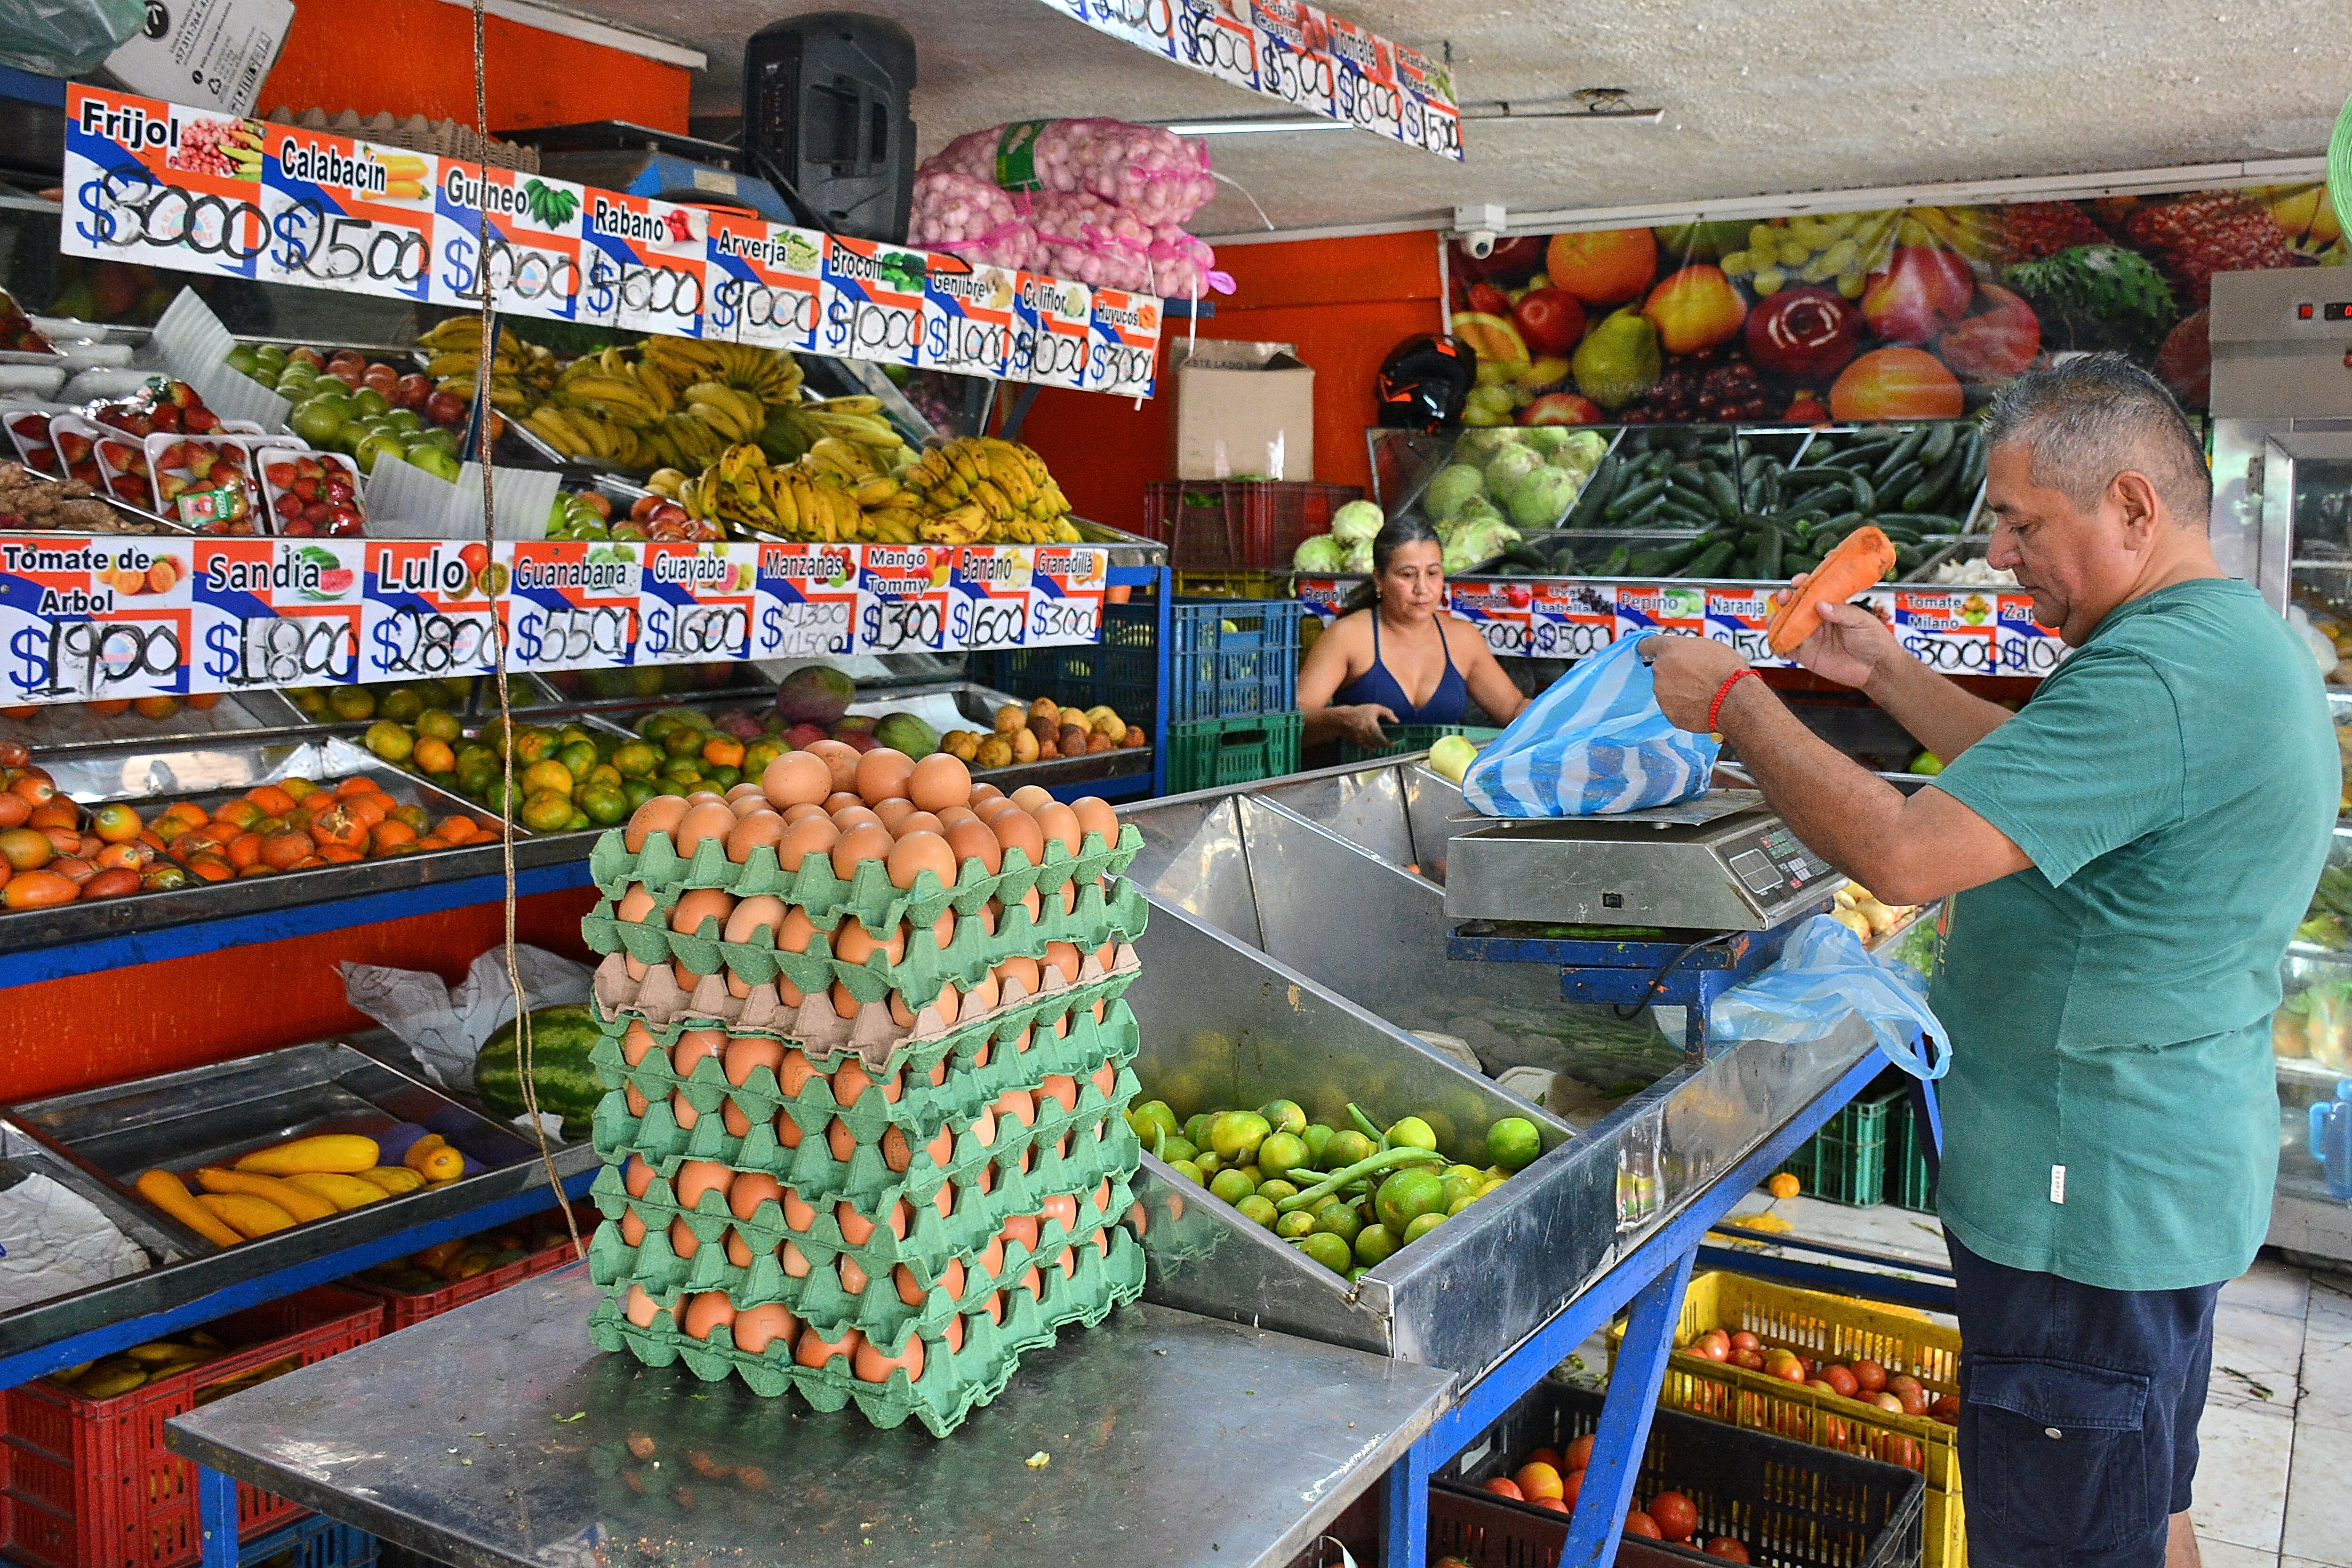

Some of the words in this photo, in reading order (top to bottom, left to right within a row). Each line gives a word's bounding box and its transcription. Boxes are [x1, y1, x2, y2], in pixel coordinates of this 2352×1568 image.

[81, 102, 179, 148] Frijol
[281, 139, 386, 190] Calabacín
[447, 170, 527, 212] Guineo
[596, 200, 663, 241] Rabano
[271, 198, 430, 282] $2500
[719, 230, 785, 265] Arverja
[934, 271, 984, 297] Genjibre
[3, 546, 108, 570] Tomate
[118, 547, 150, 570] de
[208, 556, 319, 588] Sandia
[380, 550, 464, 589] Lulo
[518, 556, 626, 587] Guanabana
[656, 554, 725, 587] Guayaba
[766, 551, 842, 578] Manzanas
[870, 550, 925, 571] Mango
[962, 551, 1012, 580] Banano
[1039, 552, 1092, 574] Granadilla
[869, 578, 927, 596] Tommy
[41, 591, 113, 612] Arbol
[1621, 593, 1677, 612] Pepino
[1713, 597, 1765, 618] Naranja
[1908, 595, 1961, 608] Tomate
[1910, 617, 1958, 628] Milano
